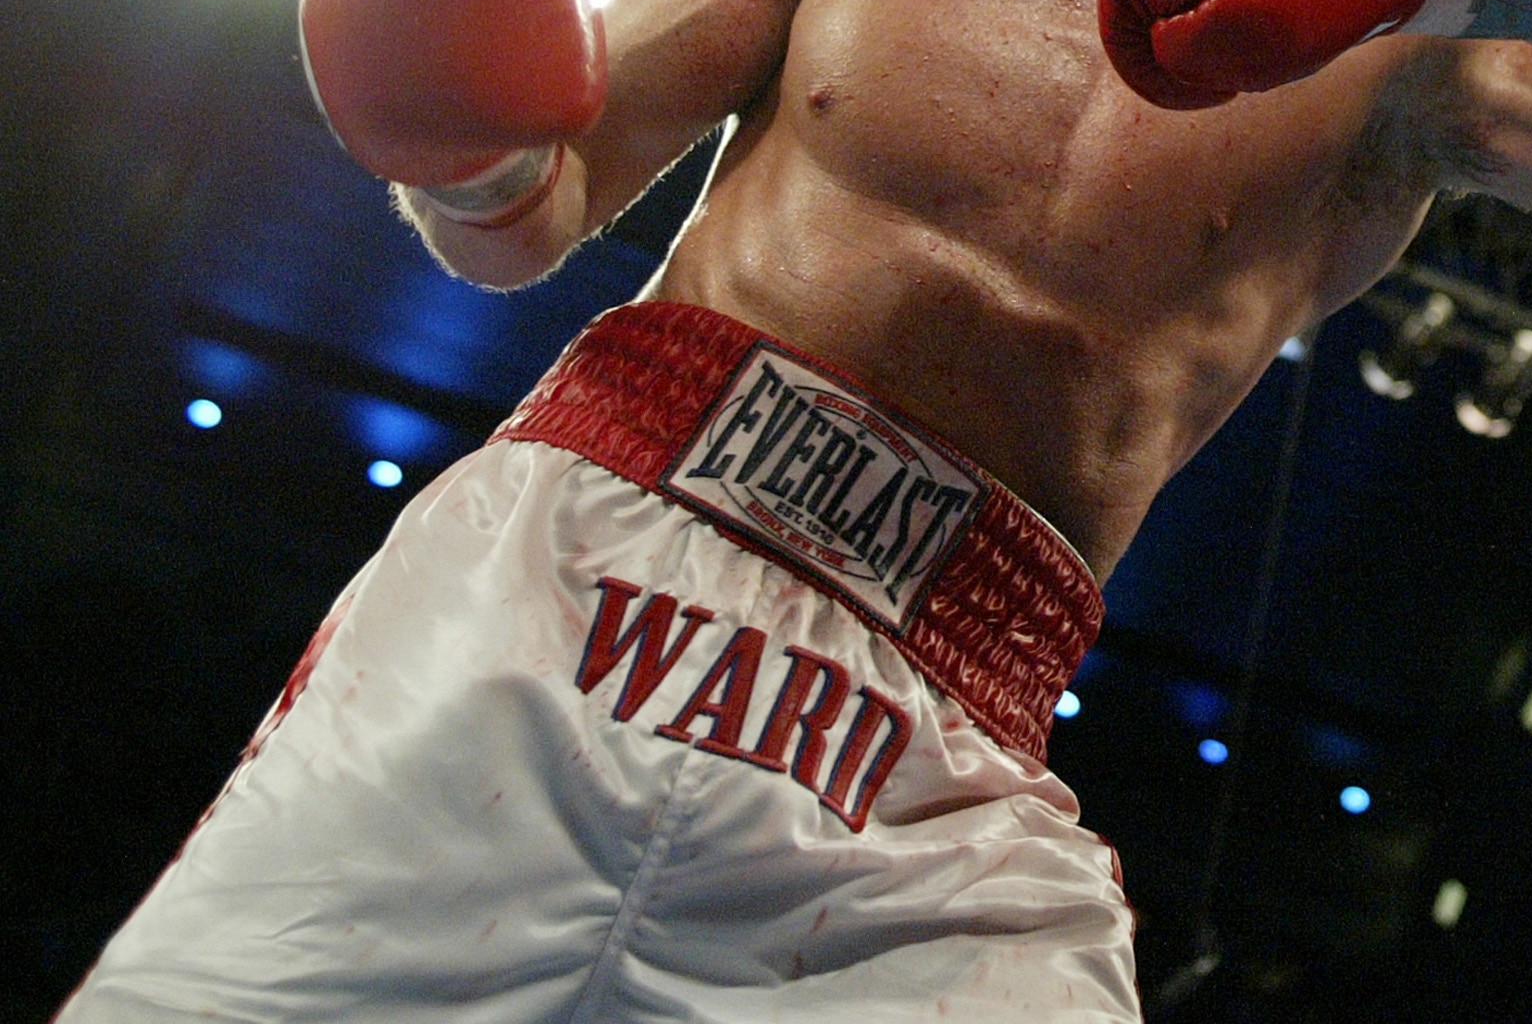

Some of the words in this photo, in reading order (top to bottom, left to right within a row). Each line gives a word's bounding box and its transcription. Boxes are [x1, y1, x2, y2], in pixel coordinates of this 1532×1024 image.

[686, 360, 973, 606] EVERLAST
[785, 531, 814, 552] NEW
[575, 576, 914, 834] WARD
